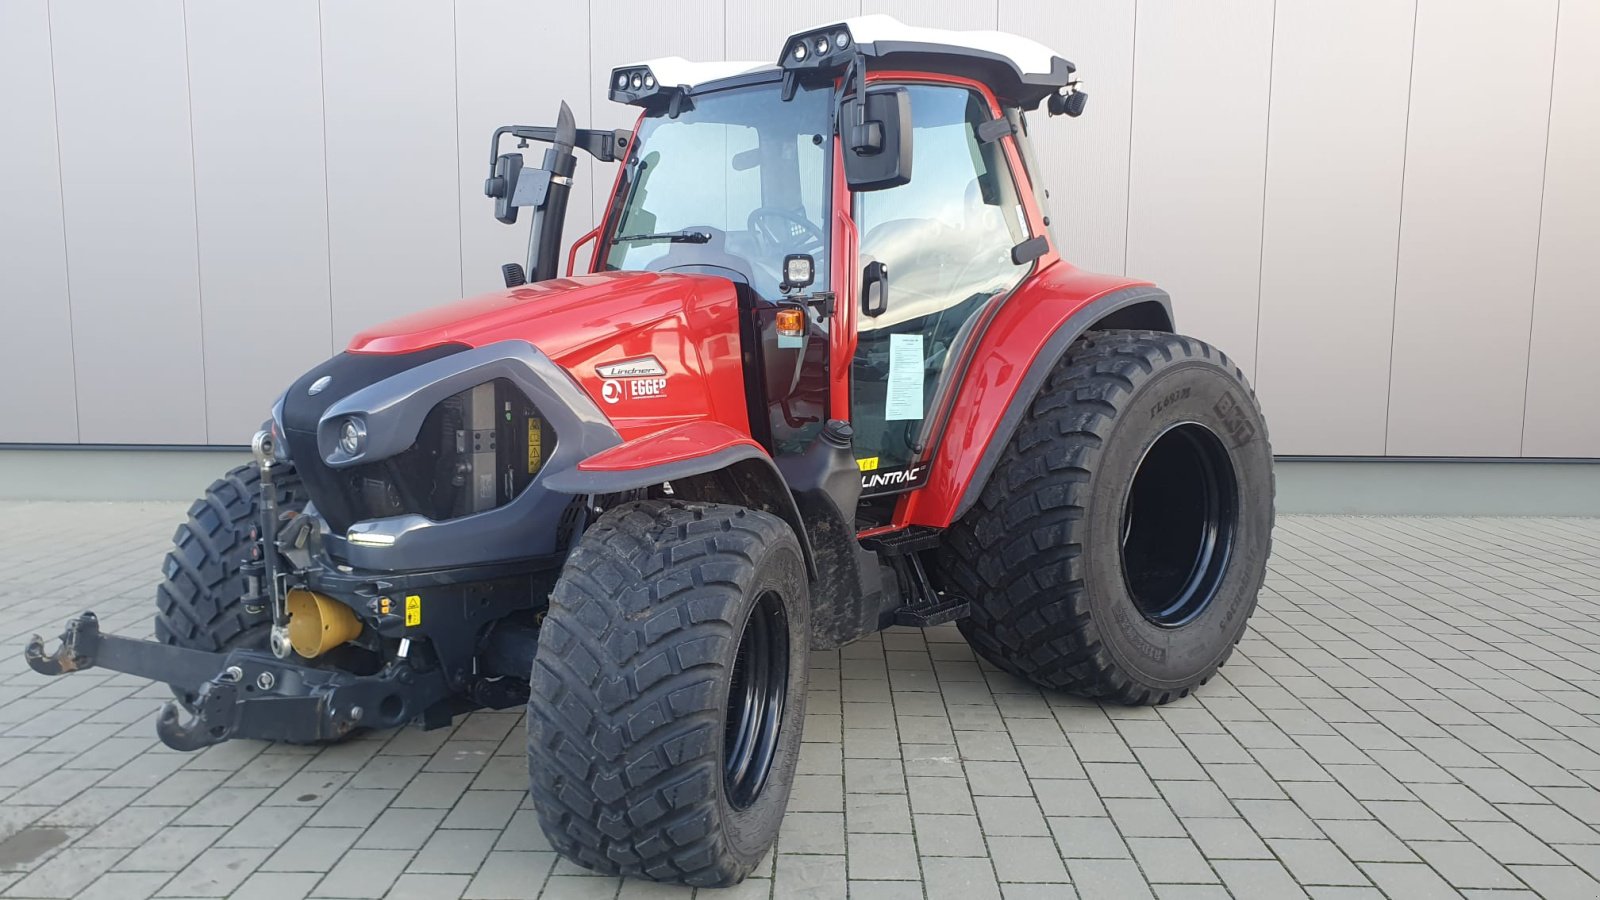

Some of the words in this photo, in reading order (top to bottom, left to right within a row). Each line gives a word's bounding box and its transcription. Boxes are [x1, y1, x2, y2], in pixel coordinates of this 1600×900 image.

[610, 367, 656, 375] Lindner
[1213, 390, 1255, 445] BKT
[861, 467, 920, 488] LINTRAC
